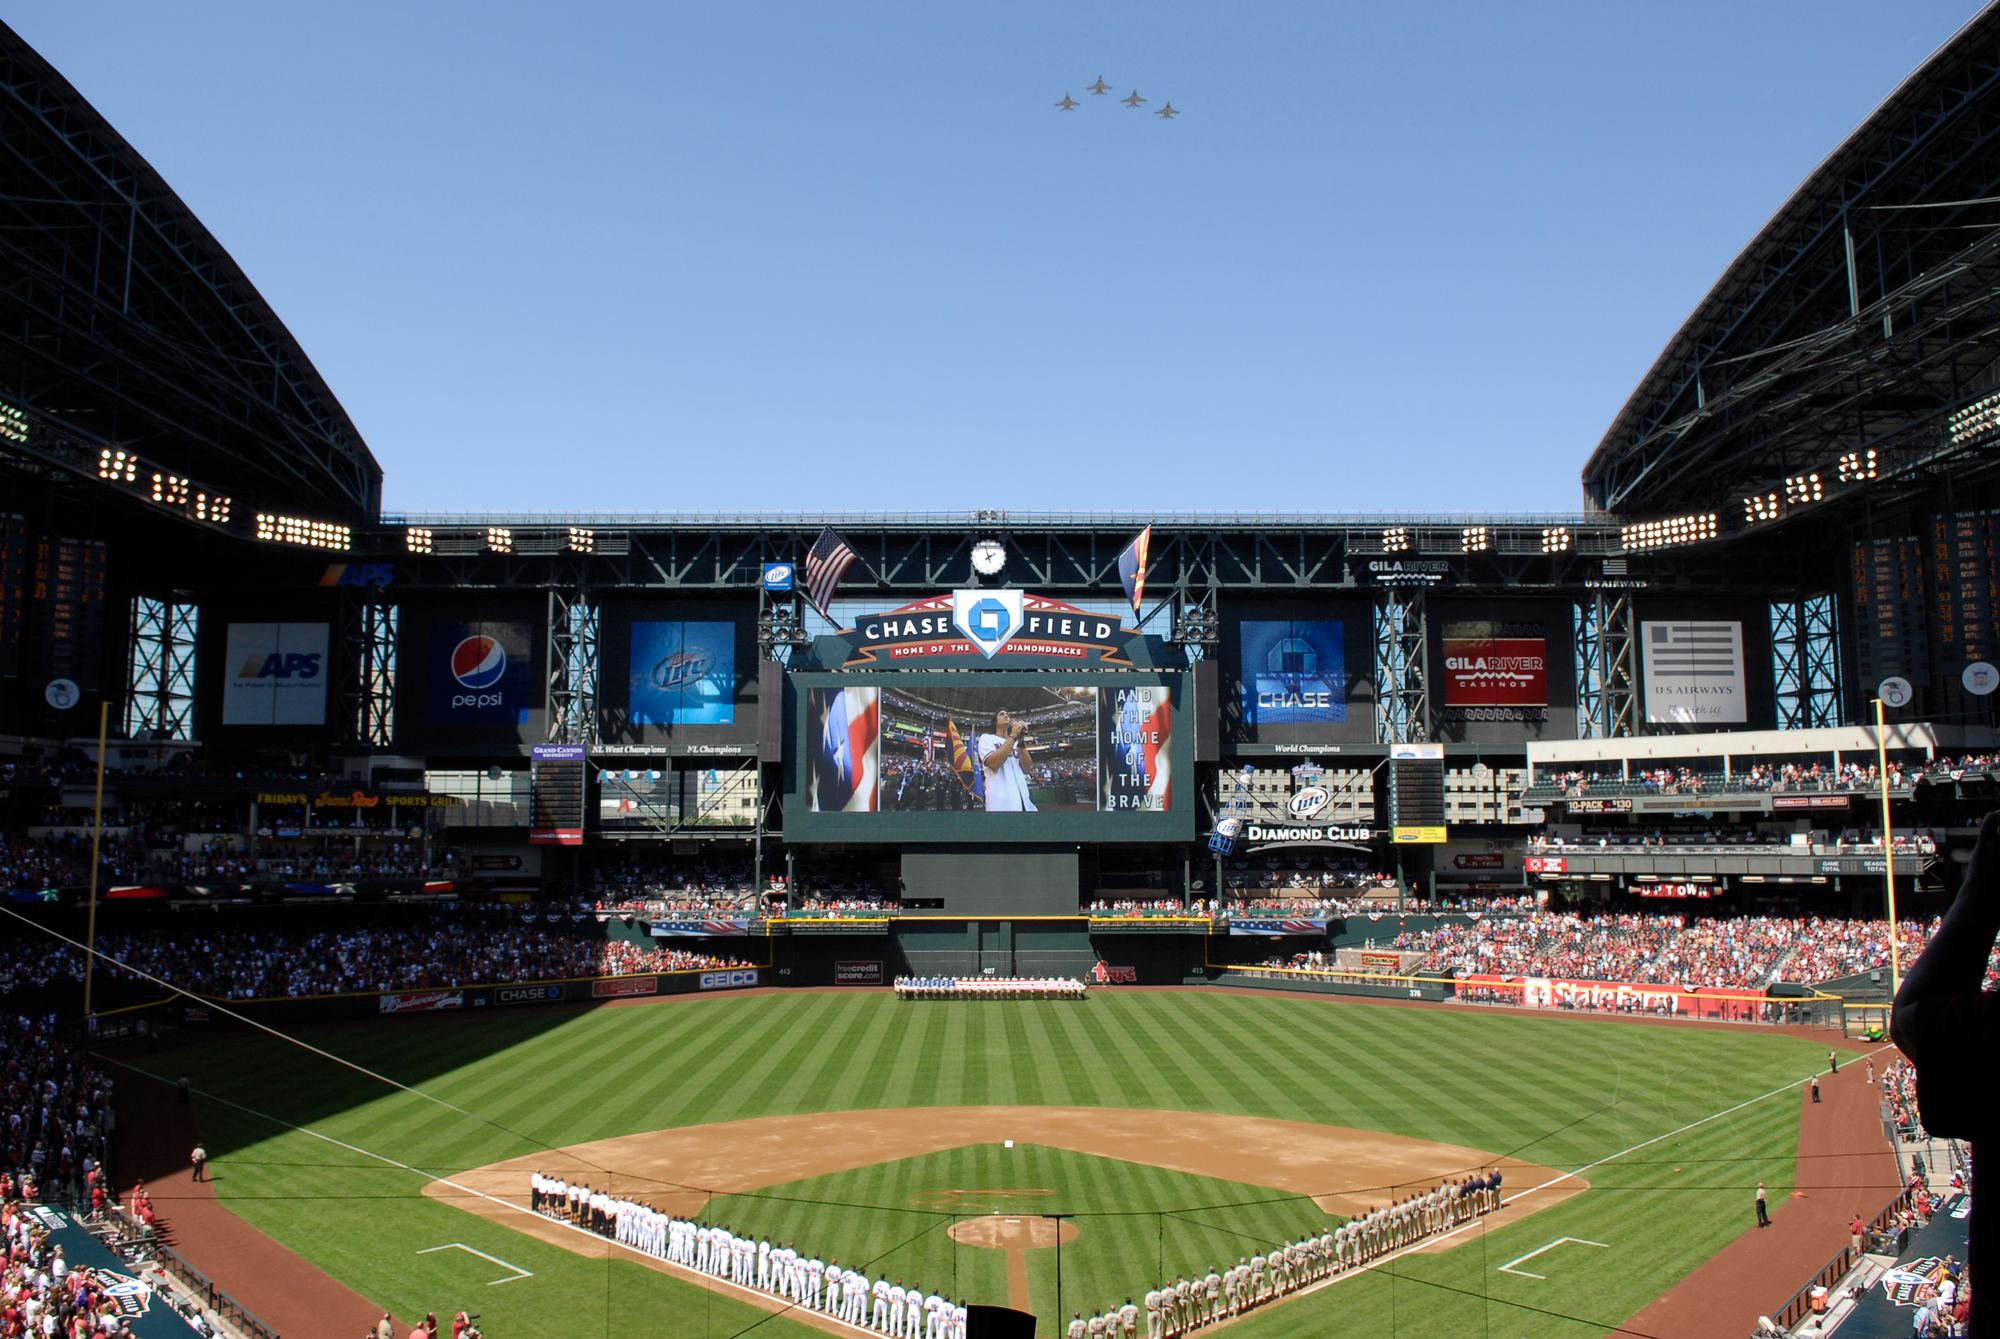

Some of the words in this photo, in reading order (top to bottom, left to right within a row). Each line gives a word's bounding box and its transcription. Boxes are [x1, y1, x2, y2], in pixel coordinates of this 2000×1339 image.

[1368, 560, 1403, 572] GILA
[1403, 560, 1449, 572] RIVER
[337, 563, 399, 588] APS
[1600, 580, 1648, 588] AIRWAYS
[865, 617, 949, 640] CHASE
[1029, 617, 1113, 640] FIELD
[895, 645, 925, 657] HOME
[931, 644, 944, 654] OF
[950, 644, 971, 653] THE
[1007, 644, 1083, 657] DIAMONDBACKS
[257, 653, 321, 679] APS
[1445, 656, 1488, 671] GILA
[1487, 656, 1543, 671] RIVER
[660, 658, 706, 688] Lite
[1117, 689, 1152, 703] AND
[1675, 686, 1733, 695] AIRWAYS
[452, 691, 503, 709] pepsi
[1257, 692, 1331, 708] CHASE
[1118, 710, 1151, 724] THE
[1110, 731, 1159, 745] HOME
[592, 746, 604, 754] NL
[605, 746, 624, 754] West
[624, 746, 667, 756] Champions
[687, 745, 698, 754] NL
[699, 745, 742, 755] Champions
[1274, 745, 1298, 753] World
[1299, 745, 1341, 755] Champions
[1125, 752, 1145, 766] OF
[1119, 774, 1152, 787] THE
[384, 795, 426, 807] SPORTS
[430, 796, 461, 807] GRILL
[1107, 795, 1164, 808] BRAVE
[1296, 794, 1323, 812] Lite
[1568, 800, 1604, 810] 10-PACK
[1612, 799, 1632, 809] $130
[1248, 826, 1323, 841] DIAMOND
[1326, 825, 1371, 841] CLUB
[1641, 882, 1709, 897] UPTOWN
[837, 964, 879, 972] freecredit
[1191, 967, 1204, 975] 413
[700, 970, 759, 989] GEICO
[500, 987, 546, 1002] CHASE
[1555, 982, 1615, 1010] State
[1617, 986, 1679, 1014] Farm
